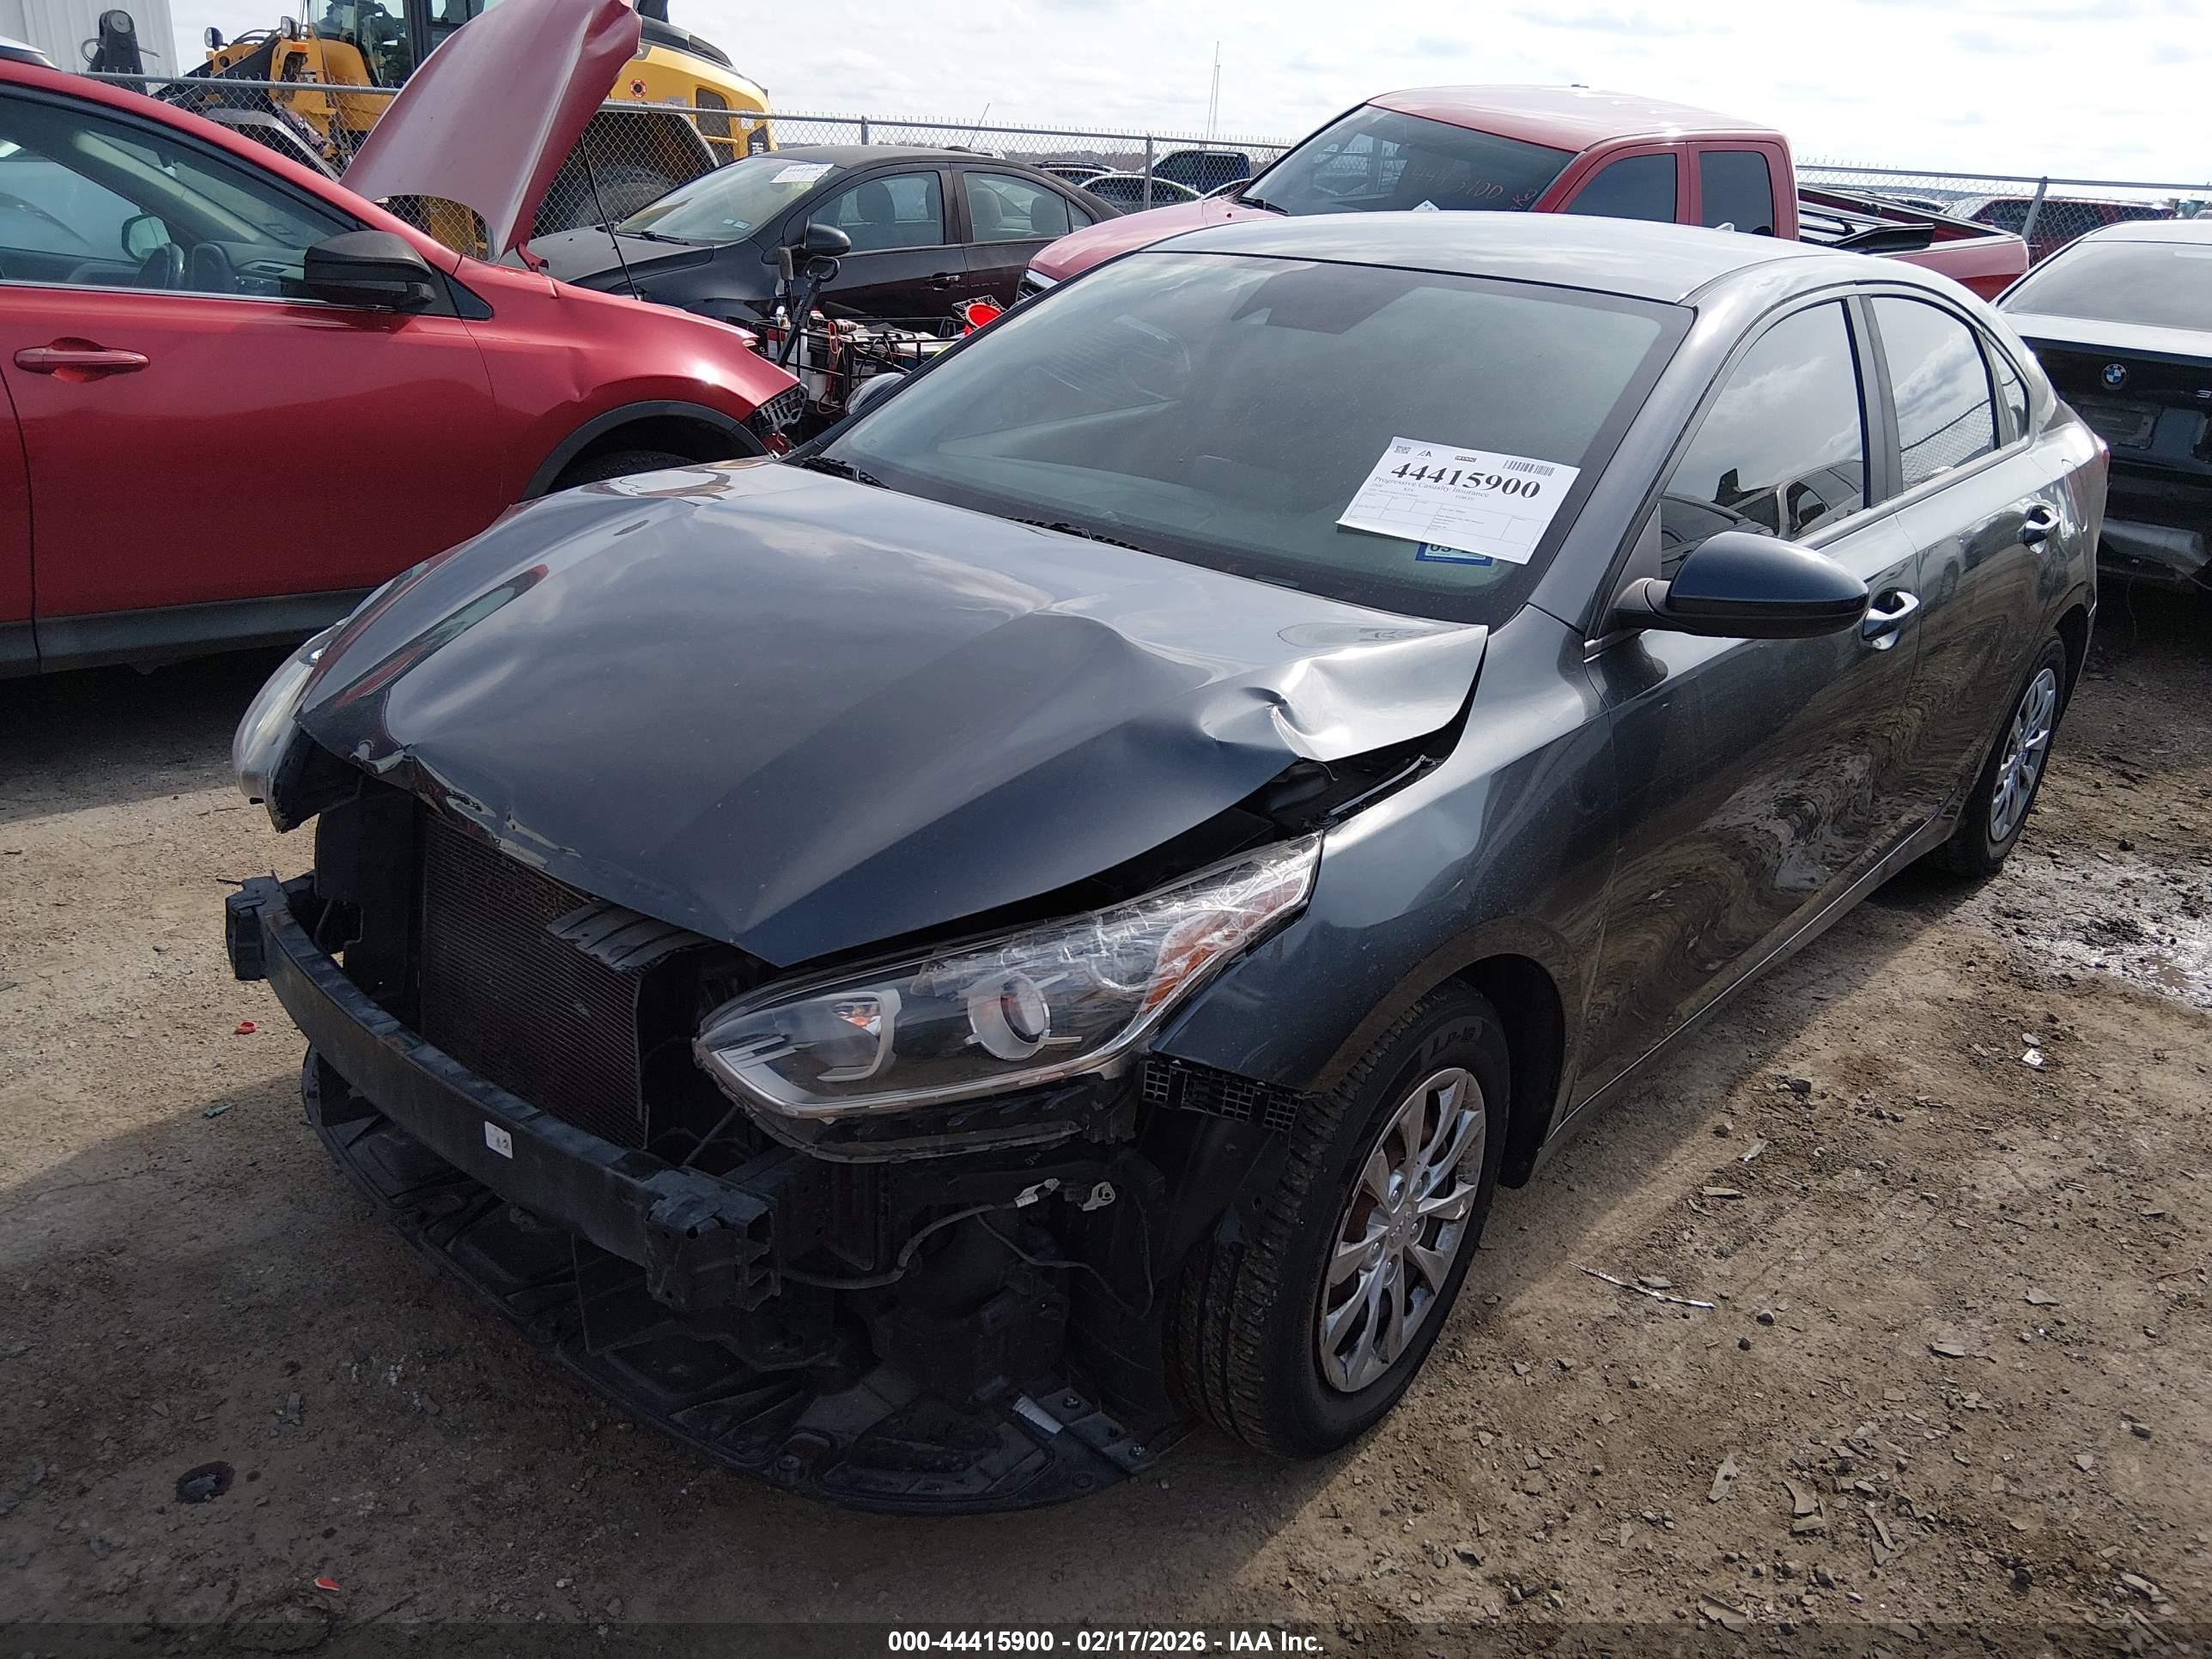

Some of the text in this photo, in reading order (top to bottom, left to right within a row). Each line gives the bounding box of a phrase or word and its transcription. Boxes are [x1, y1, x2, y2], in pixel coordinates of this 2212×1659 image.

[2196, 389, 2212, 399] 3
[1374, 476, 1417, 487] Progressive
[1418, 482, 1449, 493] Casualty
[1451, 486, 1490, 498] Insurance
[1391, 462, 1540, 498] 44415900
